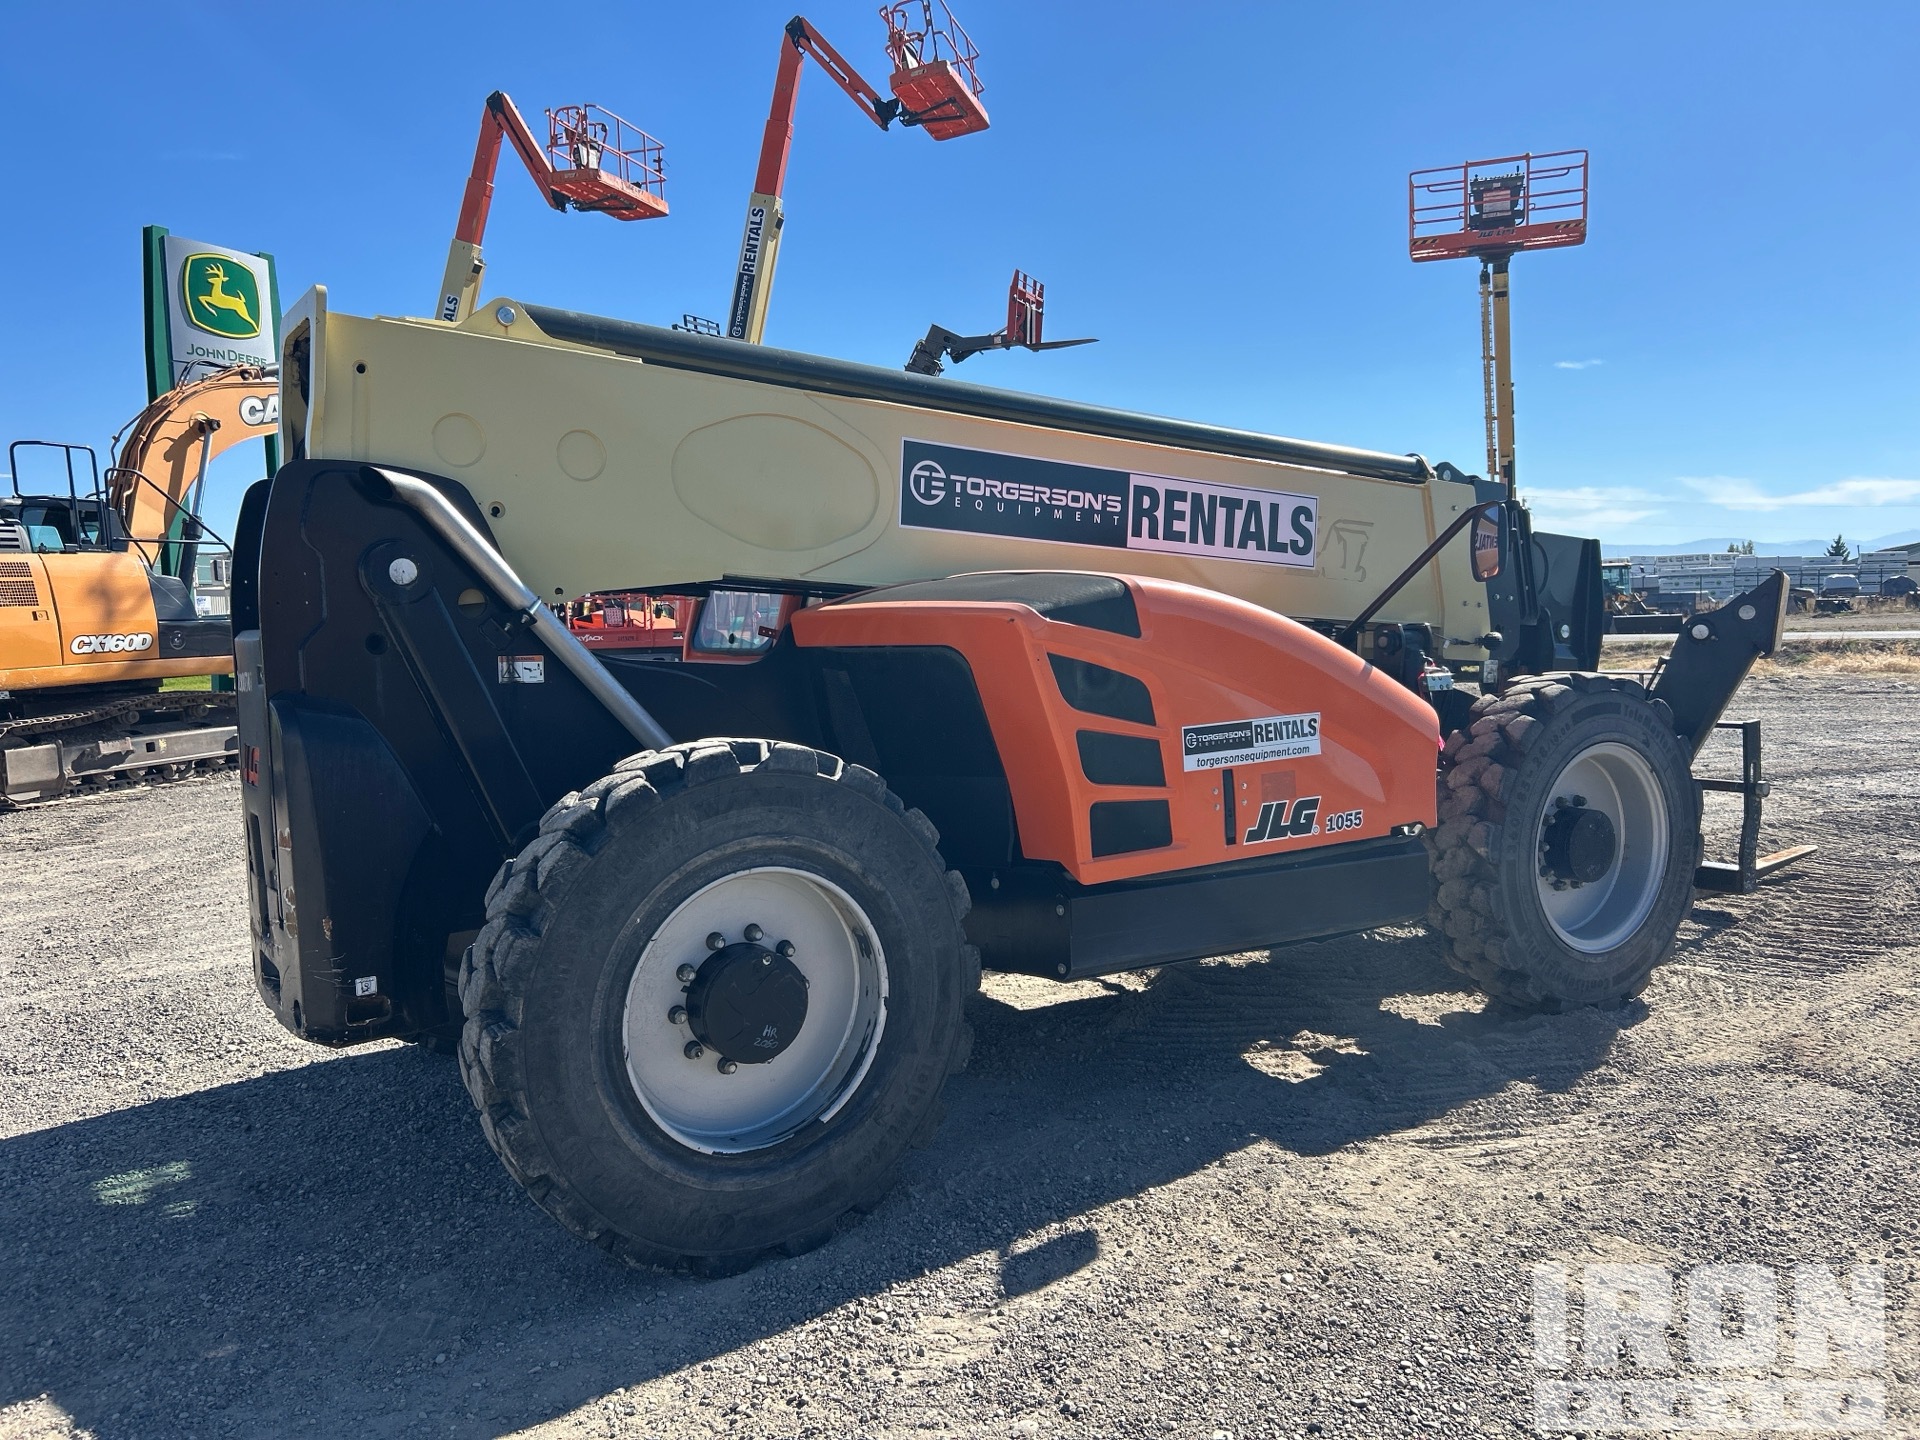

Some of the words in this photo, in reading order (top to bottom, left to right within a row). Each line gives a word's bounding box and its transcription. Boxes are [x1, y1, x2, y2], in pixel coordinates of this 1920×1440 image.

[741, 207, 765, 273] RENTALS
[186, 343, 226, 361] JOHN
[950, 474, 1122, 513] TORGERSON'S
[954, 497, 1120, 526] EQUIPMENT
[1130, 484, 1314, 557] RENTALS
[70, 633, 154, 655] CX160D
[1197, 729, 1251, 742] TORGERSON'S
[1254, 717, 1318, 743] RENTALS
[1196, 745, 1310, 768] torgersonsequipment.com
[1243, 796, 1321, 845] JLG
[1325, 809, 1364, 834] 1055
[762, 1025, 778, 1039] HR
